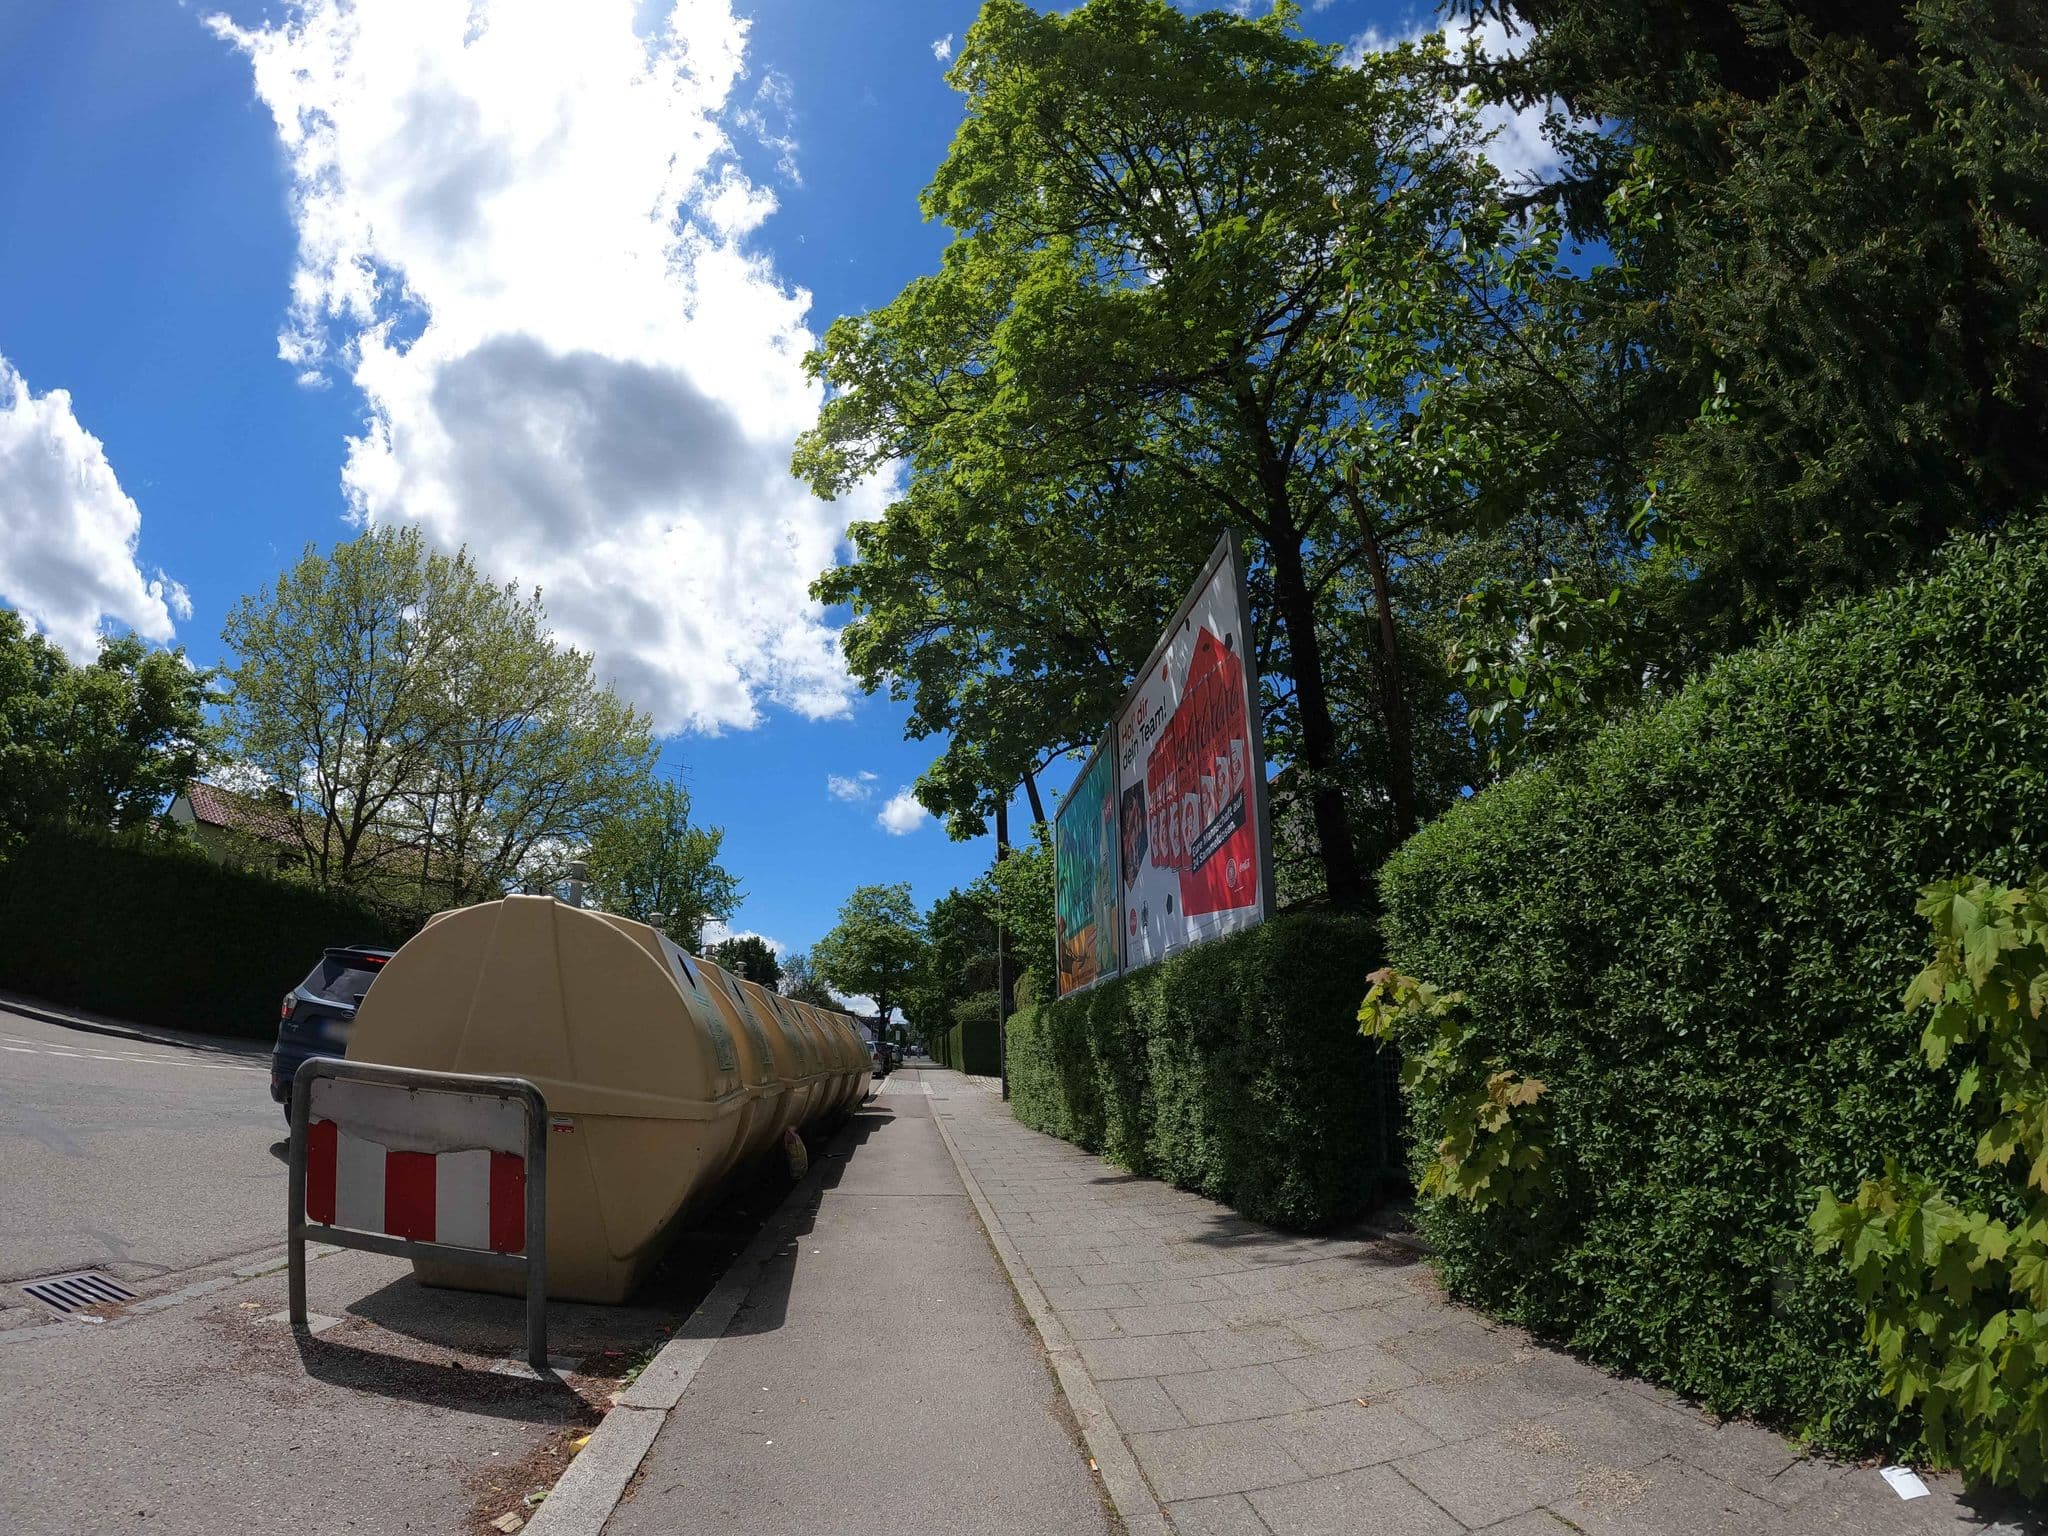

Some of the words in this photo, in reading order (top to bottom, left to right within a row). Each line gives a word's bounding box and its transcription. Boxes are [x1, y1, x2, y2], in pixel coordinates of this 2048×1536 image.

[1123, 738, 1139, 770] dein
[1140, 696, 1167, 746] Team!
[1137, 697, 1149, 725] dir
[1193, 840, 1203, 858] Eure
[1203, 806, 1233, 845] Mannschaft
[1233, 792, 1243, 813] auf
